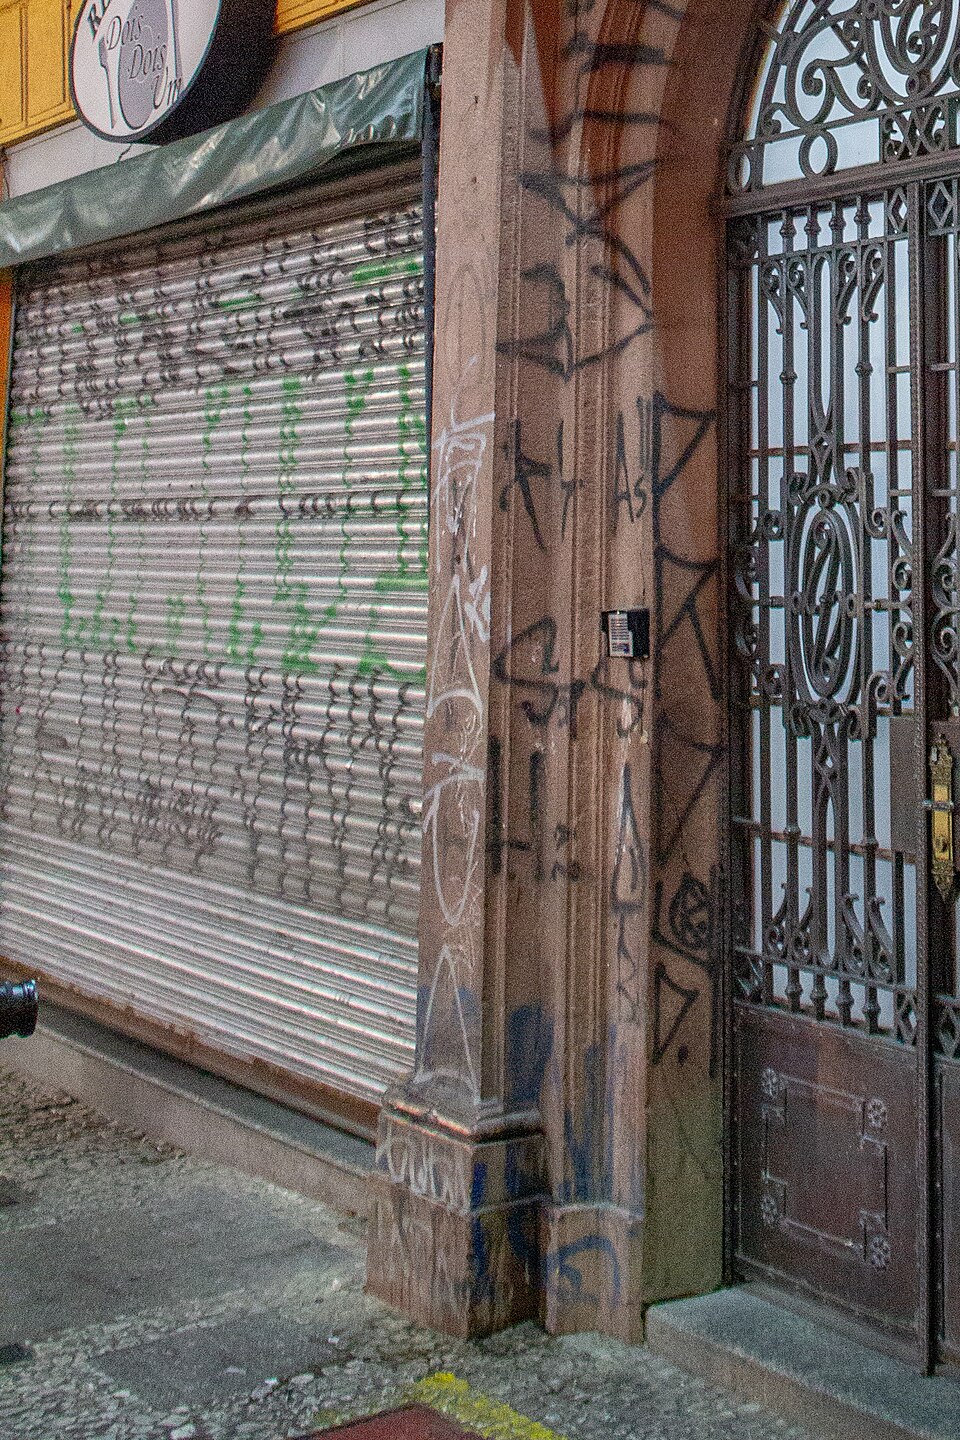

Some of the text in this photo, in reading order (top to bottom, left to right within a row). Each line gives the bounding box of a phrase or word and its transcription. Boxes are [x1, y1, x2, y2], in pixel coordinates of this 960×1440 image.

[105, 6, 143, 51] Dois
[127, 35, 167, 80] Dois
[151, 66, 182, 110] Um
